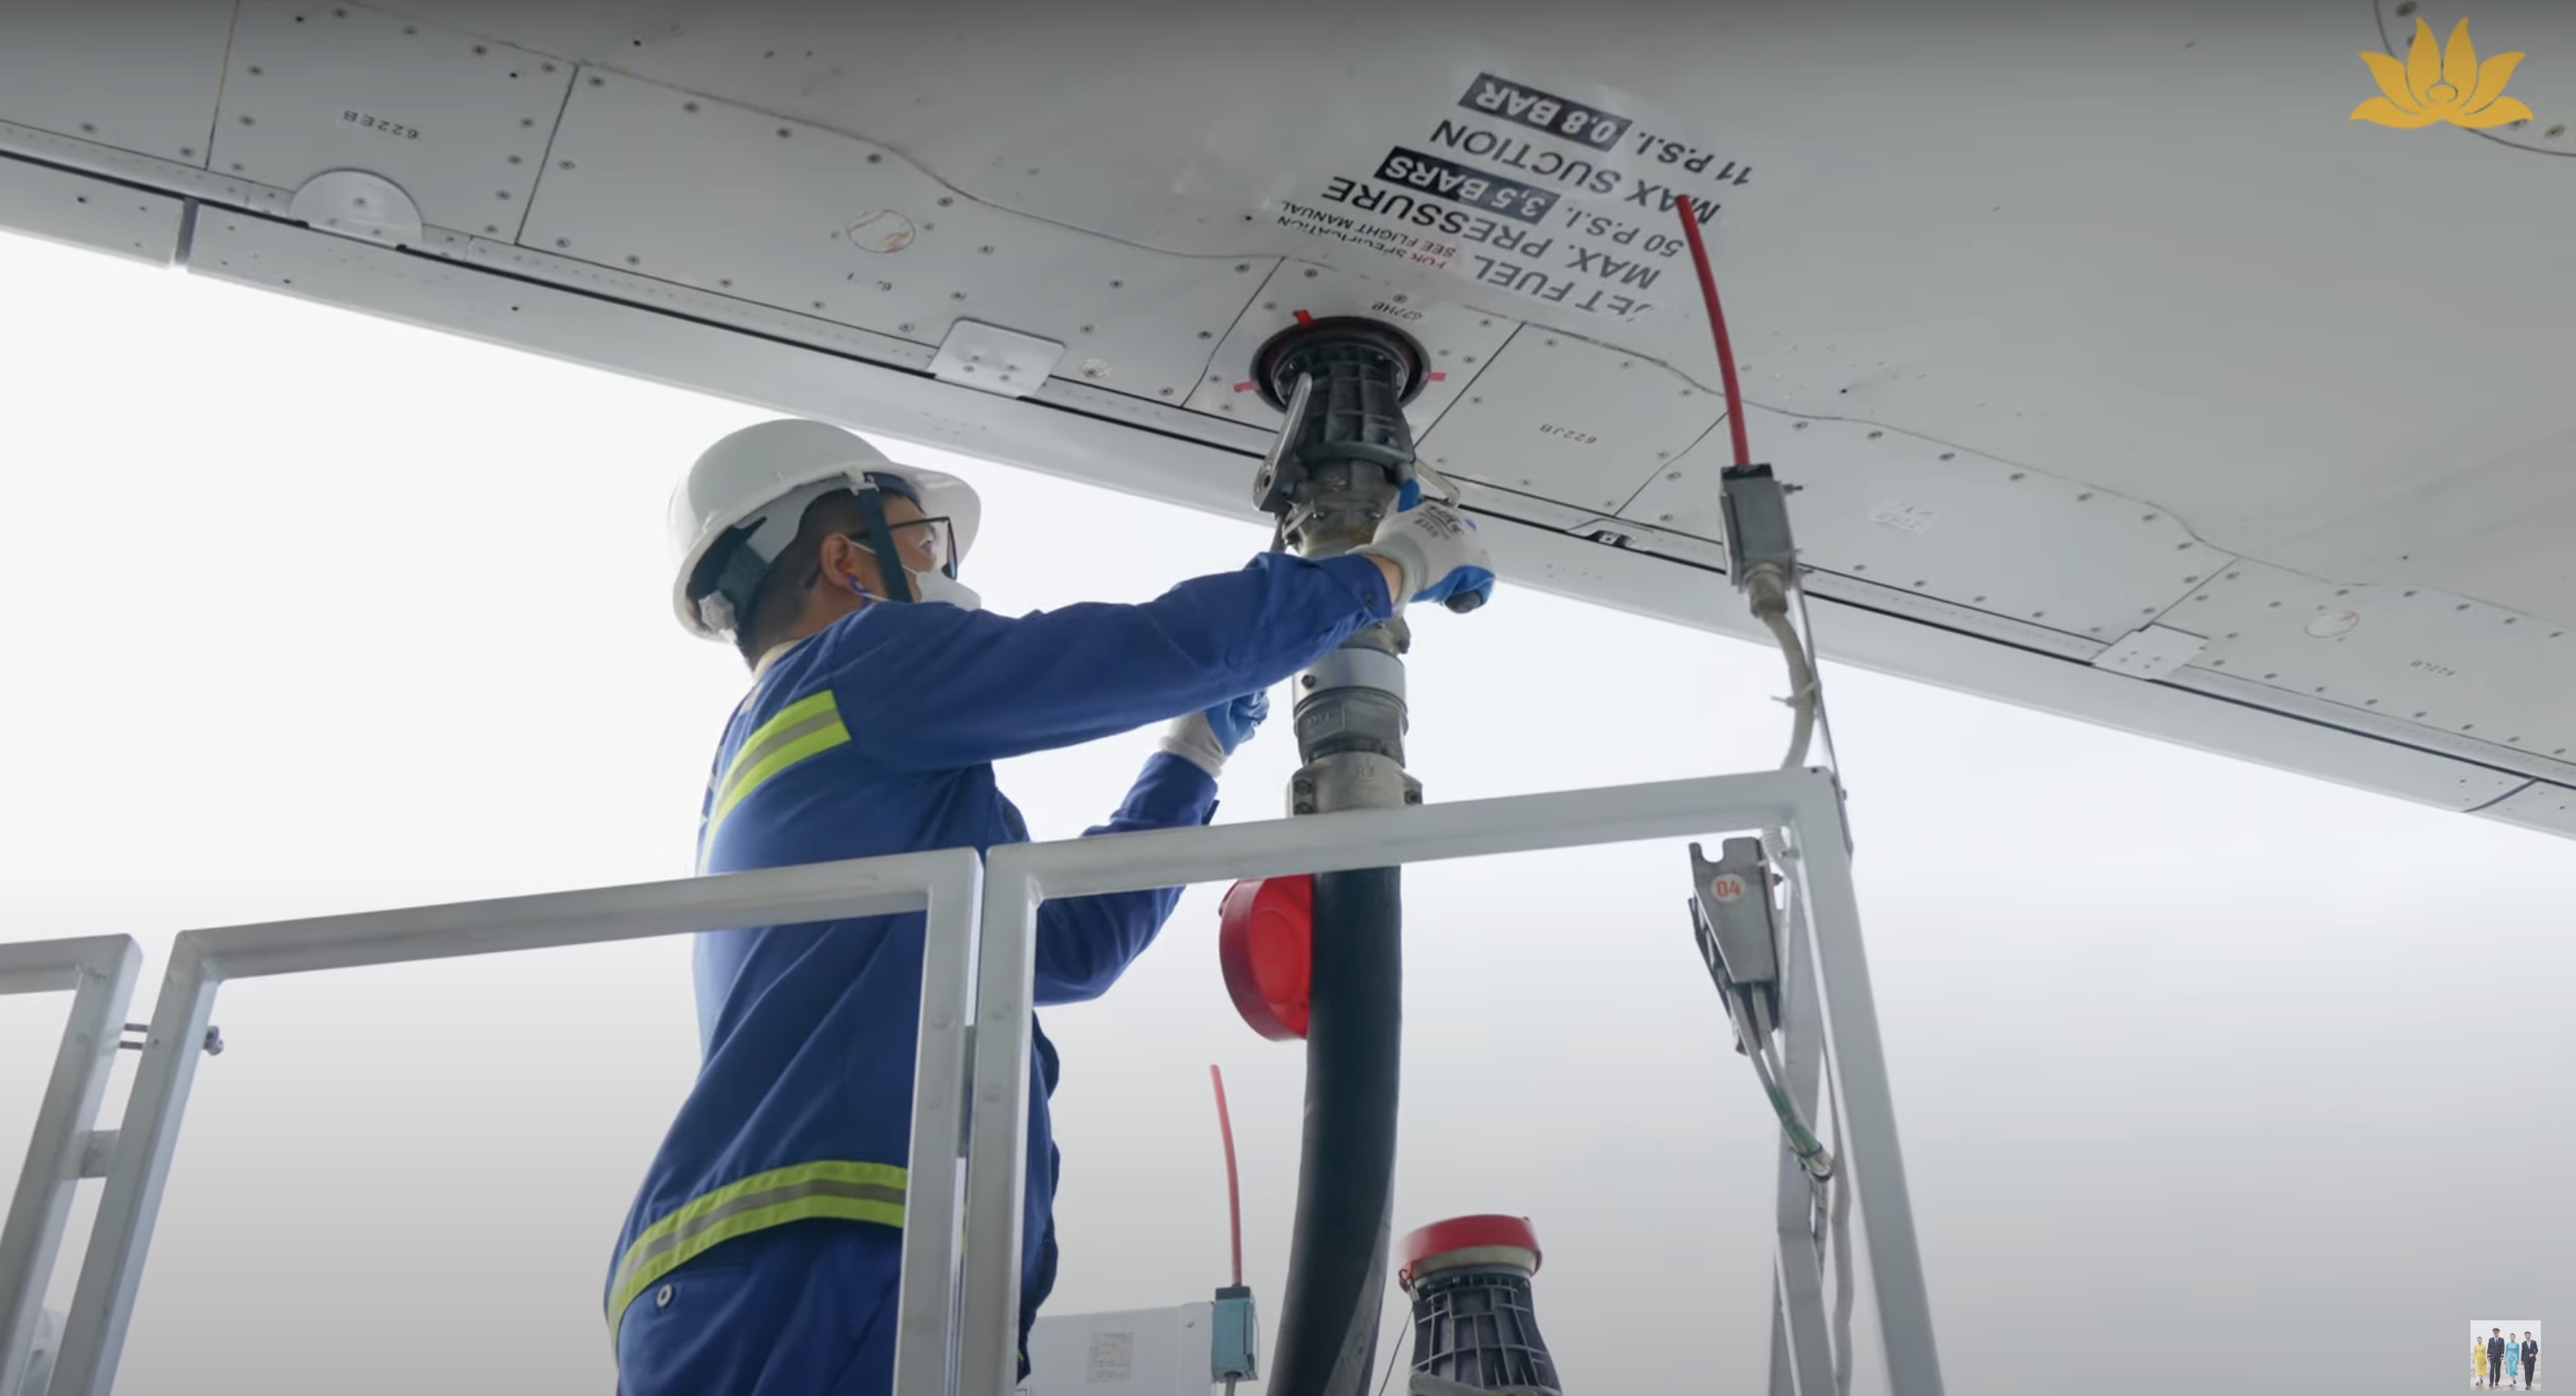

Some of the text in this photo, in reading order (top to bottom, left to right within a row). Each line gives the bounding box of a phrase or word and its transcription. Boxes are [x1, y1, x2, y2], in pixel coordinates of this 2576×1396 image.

[344, 110, 418, 140] 622EB
[1475, 82, 1561, 127] BAR
[1430, 120, 1721, 225] MAX SUCTION
[1636, 132, 1714, 174] P.S.I.
[1716, 161, 1752, 185] 11
[1281, 200, 1456, 258] SEE FLIGHT MANUAL
[1384, 156, 1685, 258] 50 P.S.I. 3,5 BARS
[1321, 177, 1662, 290] MAX. PRESSURE
[1474, 253, 1575, 302] FUEL
[1716, 880, 1741, 898] 04
